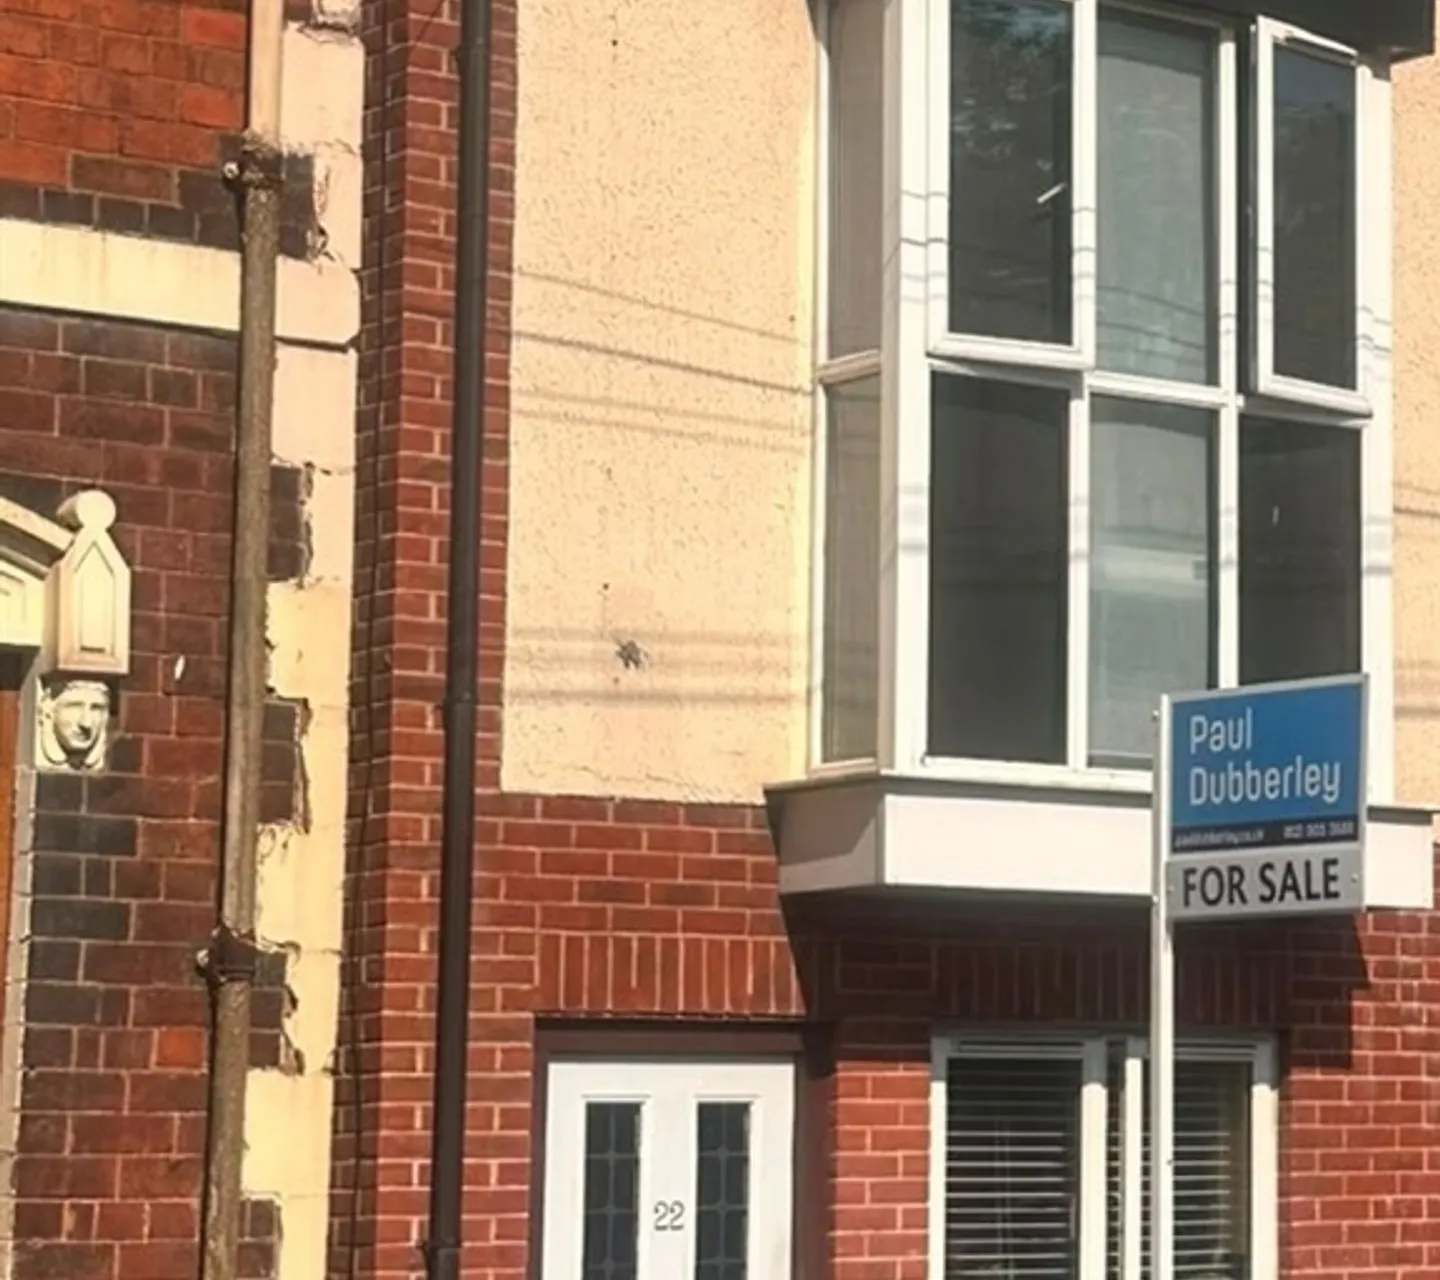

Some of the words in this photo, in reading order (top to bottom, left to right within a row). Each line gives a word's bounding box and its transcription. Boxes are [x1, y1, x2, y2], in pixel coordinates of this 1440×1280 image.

[1190, 706, 1253, 754] Paul
[1190, 755, 1341, 805] Dubberley
[1182, 864, 1248, 908] FOR
[1258, 857, 1341, 904] SALE
[653, 1199, 685, 1231] 22
